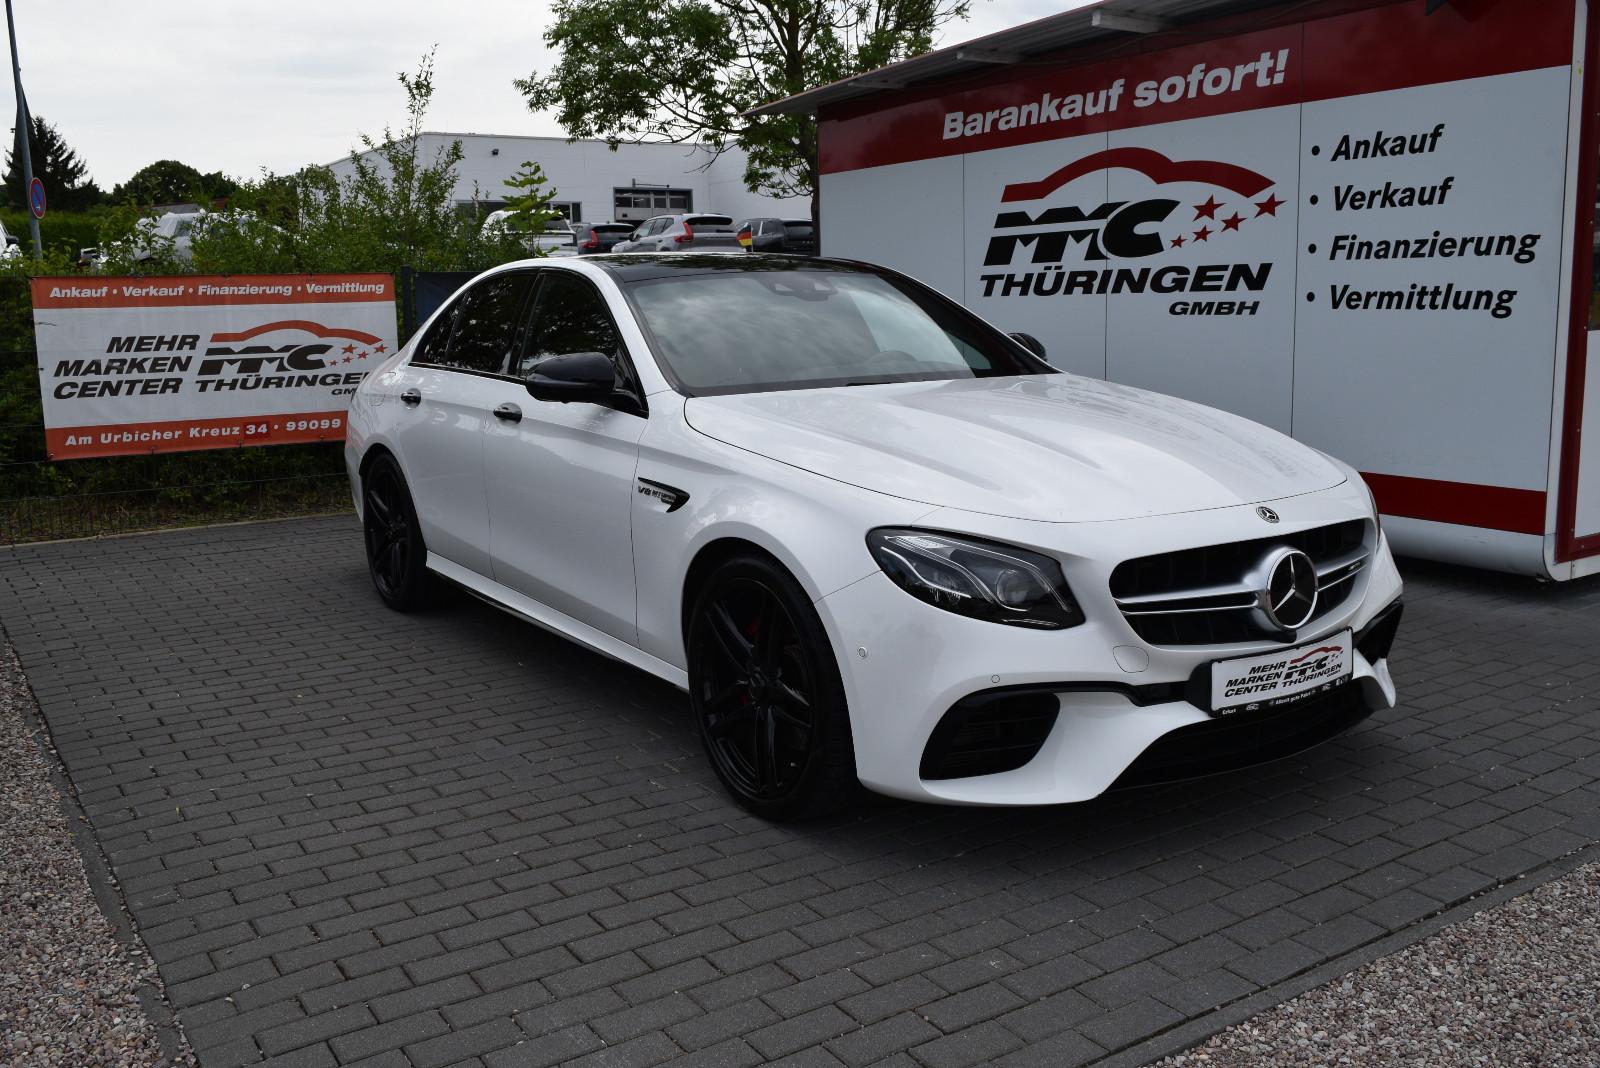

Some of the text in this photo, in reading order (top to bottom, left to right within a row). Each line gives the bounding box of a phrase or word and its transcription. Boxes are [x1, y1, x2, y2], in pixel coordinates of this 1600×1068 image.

[942, 48, 1290, 140] Barankauf sofort!
[1330, 123, 1445, 161] Ankauf
[1334, 176, 1454, 211] Verkauf
[983, 198, 1181, 266] MMC
[1329, 230, 1541, 264] Finanzierung
[50, 282, 385, 298] Ankauf Verkauf Finanzierung Vermittlung
[980, 262, 1273, 297] THÜRINGEN
[1168, 300, 1260, 316] GMBH
[1330, 283, 1518, 319] Vermittlung
[106, 334, 201, 353] MEHR
[53, 355, 193, 377] MARKEN
[198, 344, 334, 375] MMC
[53, 377, 184, 400] CENTER
[65, 418, 342, 446] Am Urbicher Kreuz 34 99099
[1224, 681, 1278, 698] CENTER
[1282, 662, 1343, 688] THÜRINGEN
[1226, 671, 1283, 688] MARKEN
[1249, 660, 1287, 675] MEHR
